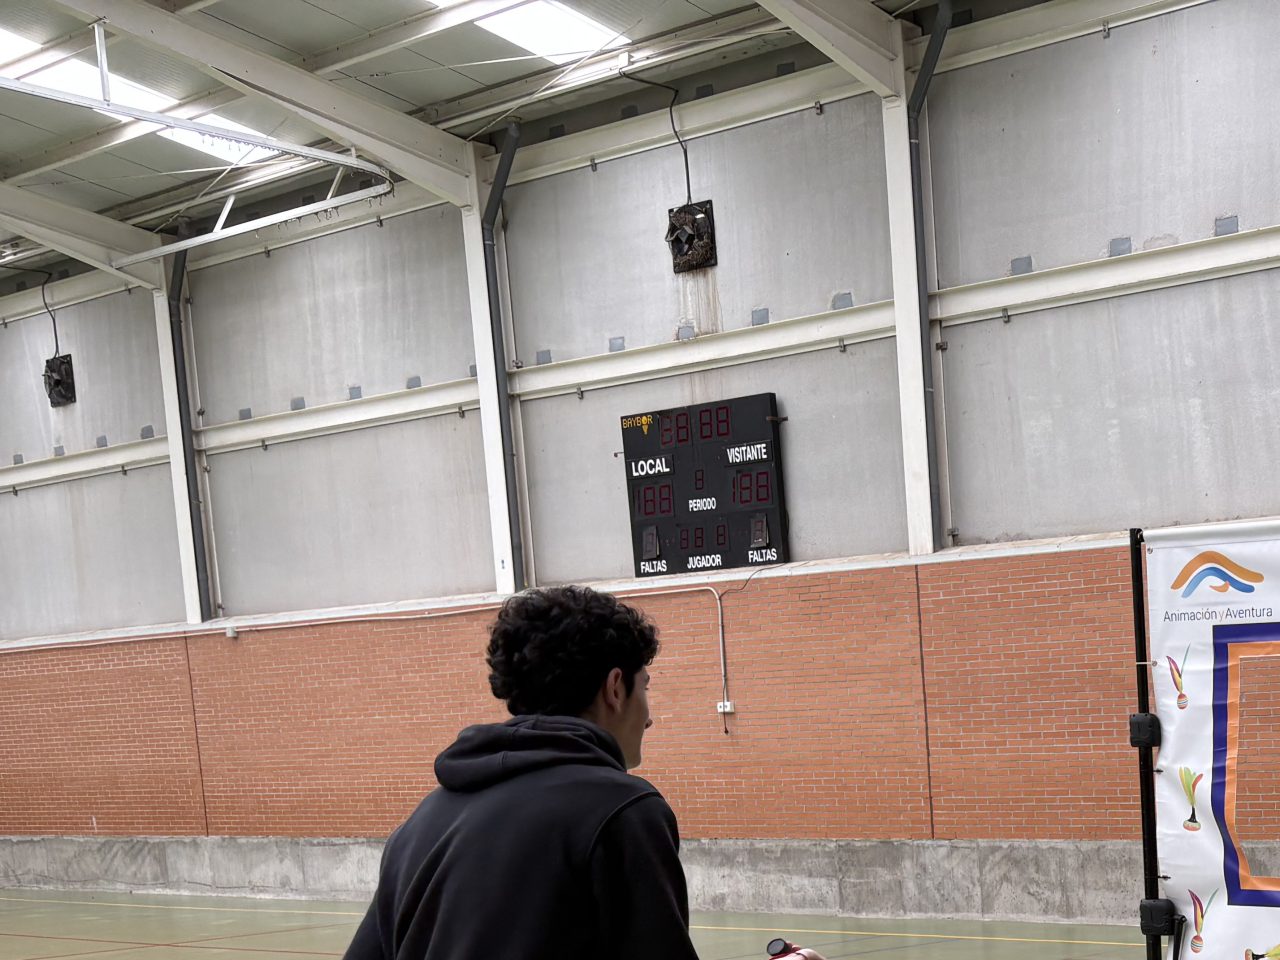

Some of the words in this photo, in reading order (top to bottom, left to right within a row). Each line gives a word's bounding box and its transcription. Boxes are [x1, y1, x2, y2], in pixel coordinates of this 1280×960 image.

[727, 443, 767, 463] VISITANTE
[631, 457, 670, 477] LOCAL
[688, 497, 717, 512] PERIODO
[687, 554, 722, 569] JUGADOR
[748, 548, 778, 563] FALTAS
[640, 560, 667, 574] FALTAS
[1163, 608, 1218, 622] Animación
[1225, 606, 1273, 619] Aventura
